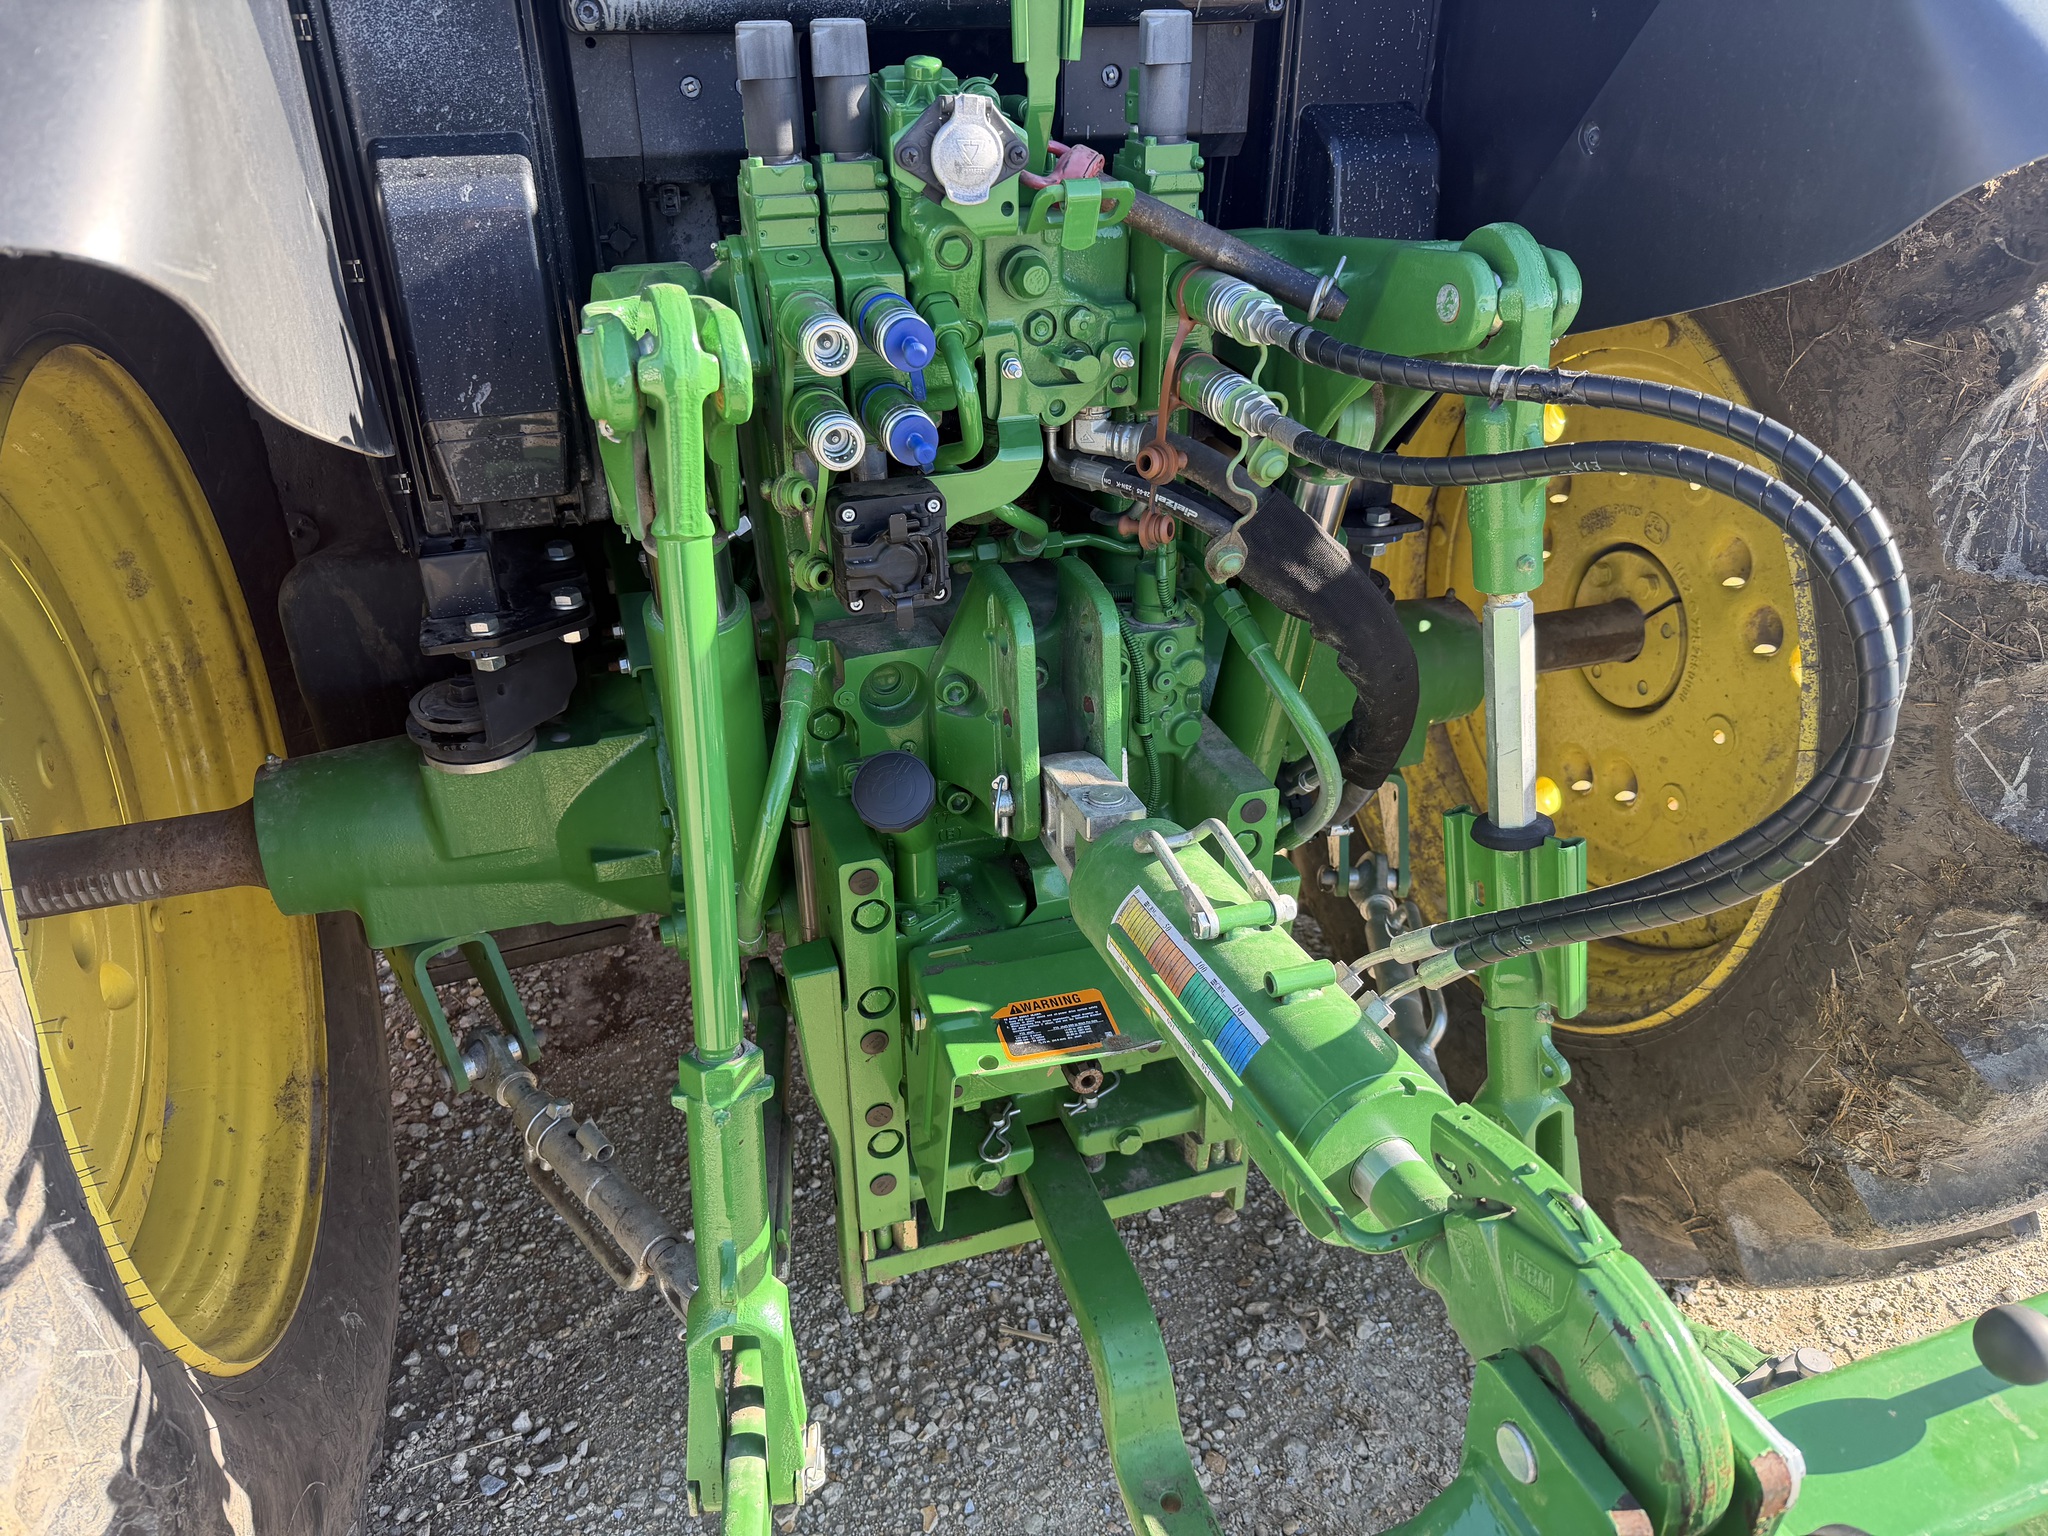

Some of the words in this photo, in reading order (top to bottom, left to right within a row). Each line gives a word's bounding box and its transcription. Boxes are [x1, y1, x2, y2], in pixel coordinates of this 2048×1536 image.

[1162, 923, 1172, 932] 50
[1195, 961, 1208, 973] 100
[1020, 993, 1082, 1013] WARNING
[1232, 1004, 1246, 1017] 150
